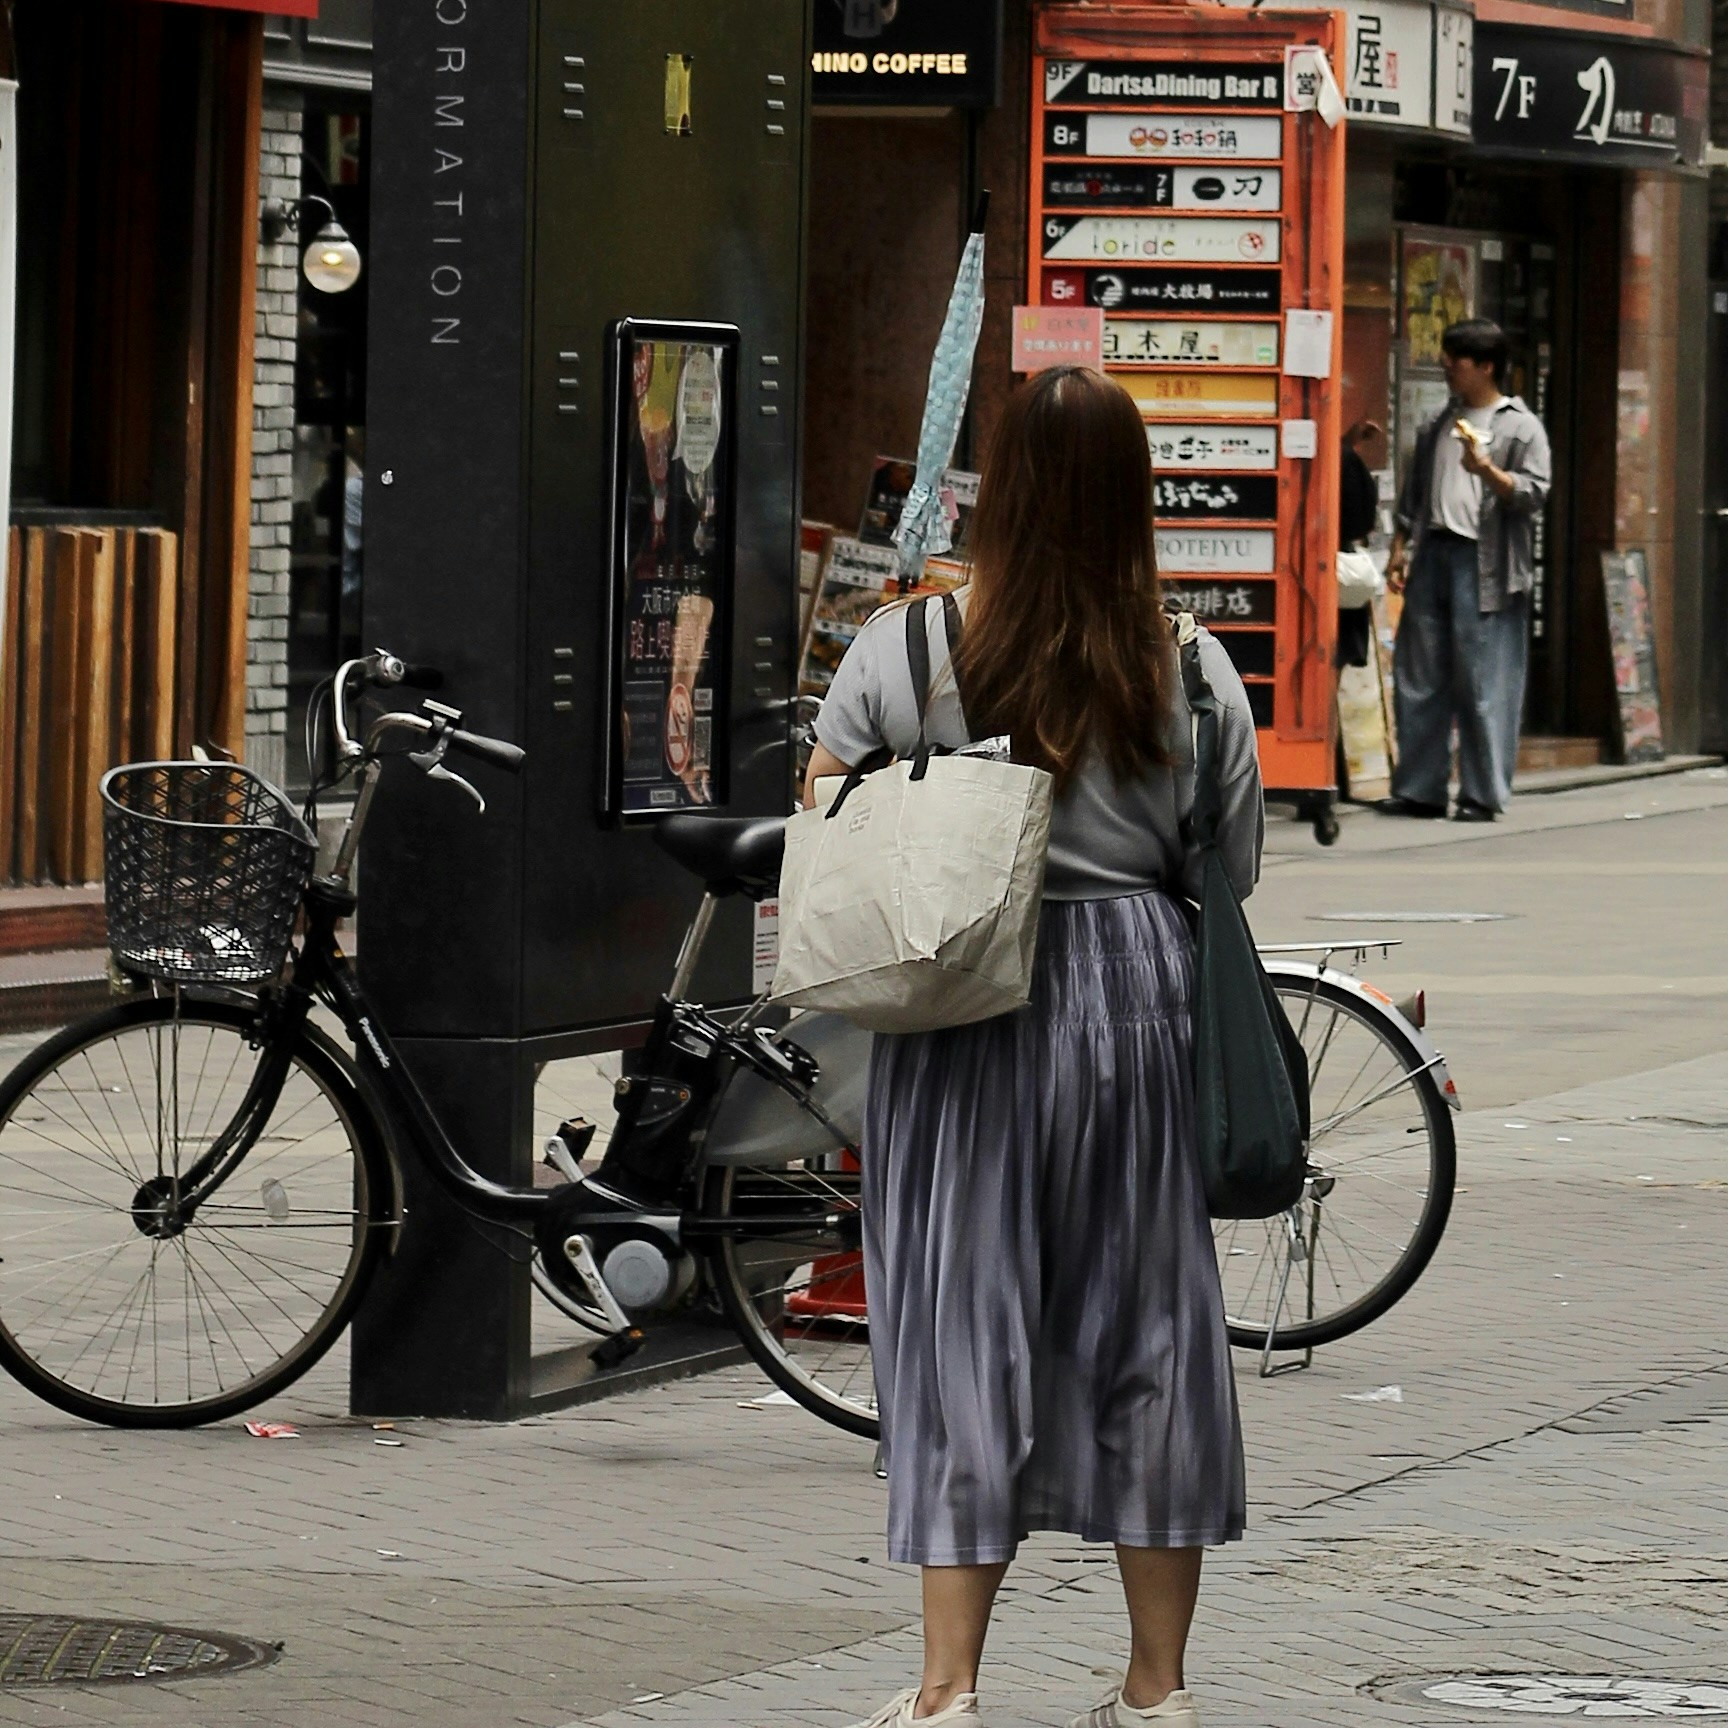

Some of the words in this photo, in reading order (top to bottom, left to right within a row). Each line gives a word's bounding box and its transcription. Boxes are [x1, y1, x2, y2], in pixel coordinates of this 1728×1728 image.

[873, 53, 967, 74] COFFEE
[1087, 72, 1221, 100] Darts&Dining
[1224, 75, 1260, 98] Bar
[1263, 76, 1277, 98] R
[1491, 56, 1537, 122] 7F
[1053, 126, 1079, 145] 8F
[1051, 279, 1075, 300] 5F
